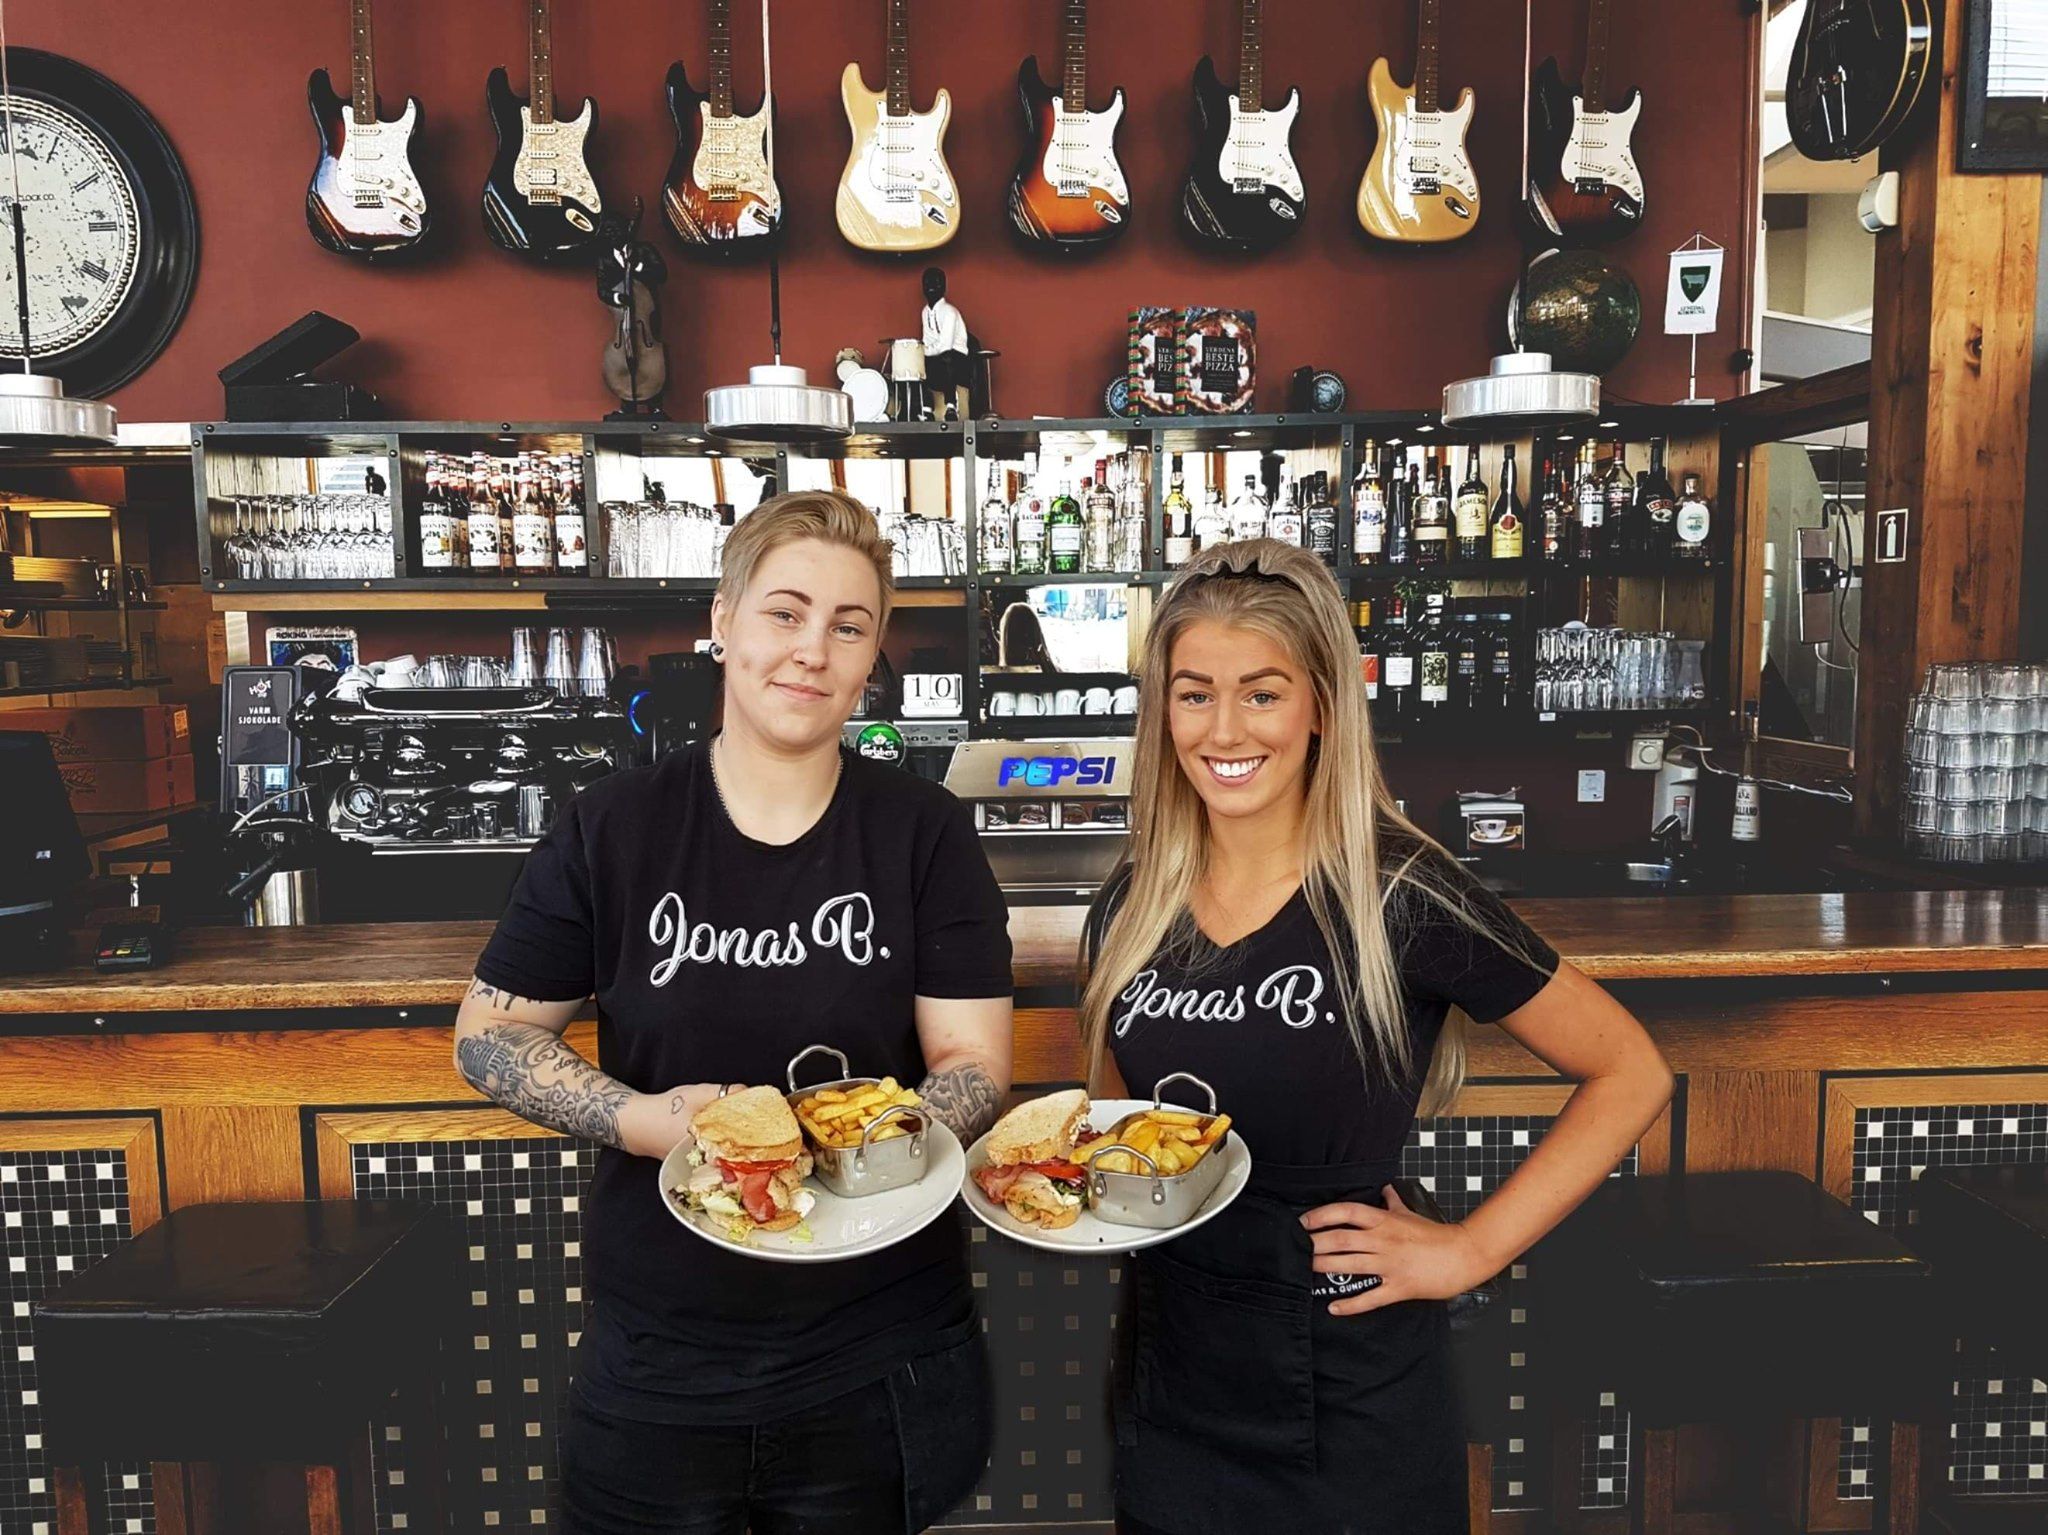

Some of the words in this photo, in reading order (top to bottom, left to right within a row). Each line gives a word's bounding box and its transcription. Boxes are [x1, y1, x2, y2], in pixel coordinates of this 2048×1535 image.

[1158, 353, 1173, 363] BES
[1205, 353, 1235, 363] BESTE
[1158, 363, 1173, 372] PIZ
[1205, 362, 1235, 372] PIZZA
[1355, 493, 1382, 502] LILLE
[248, 679, 272, 696] HOT
[249, 706, 271, 715] VARM
[238, 716, 281, 725] SJOKOLADE
[860, 743, 898, 760] Carlsberg
[998, 756, 1117, 787] PEPSI
[649, 891, 808, 988] Jonas
[811, 891, 891, 966] B.
[1115, 969, 1246, 1038] Jonas
[1255, 964, 1336, 1029] B.
